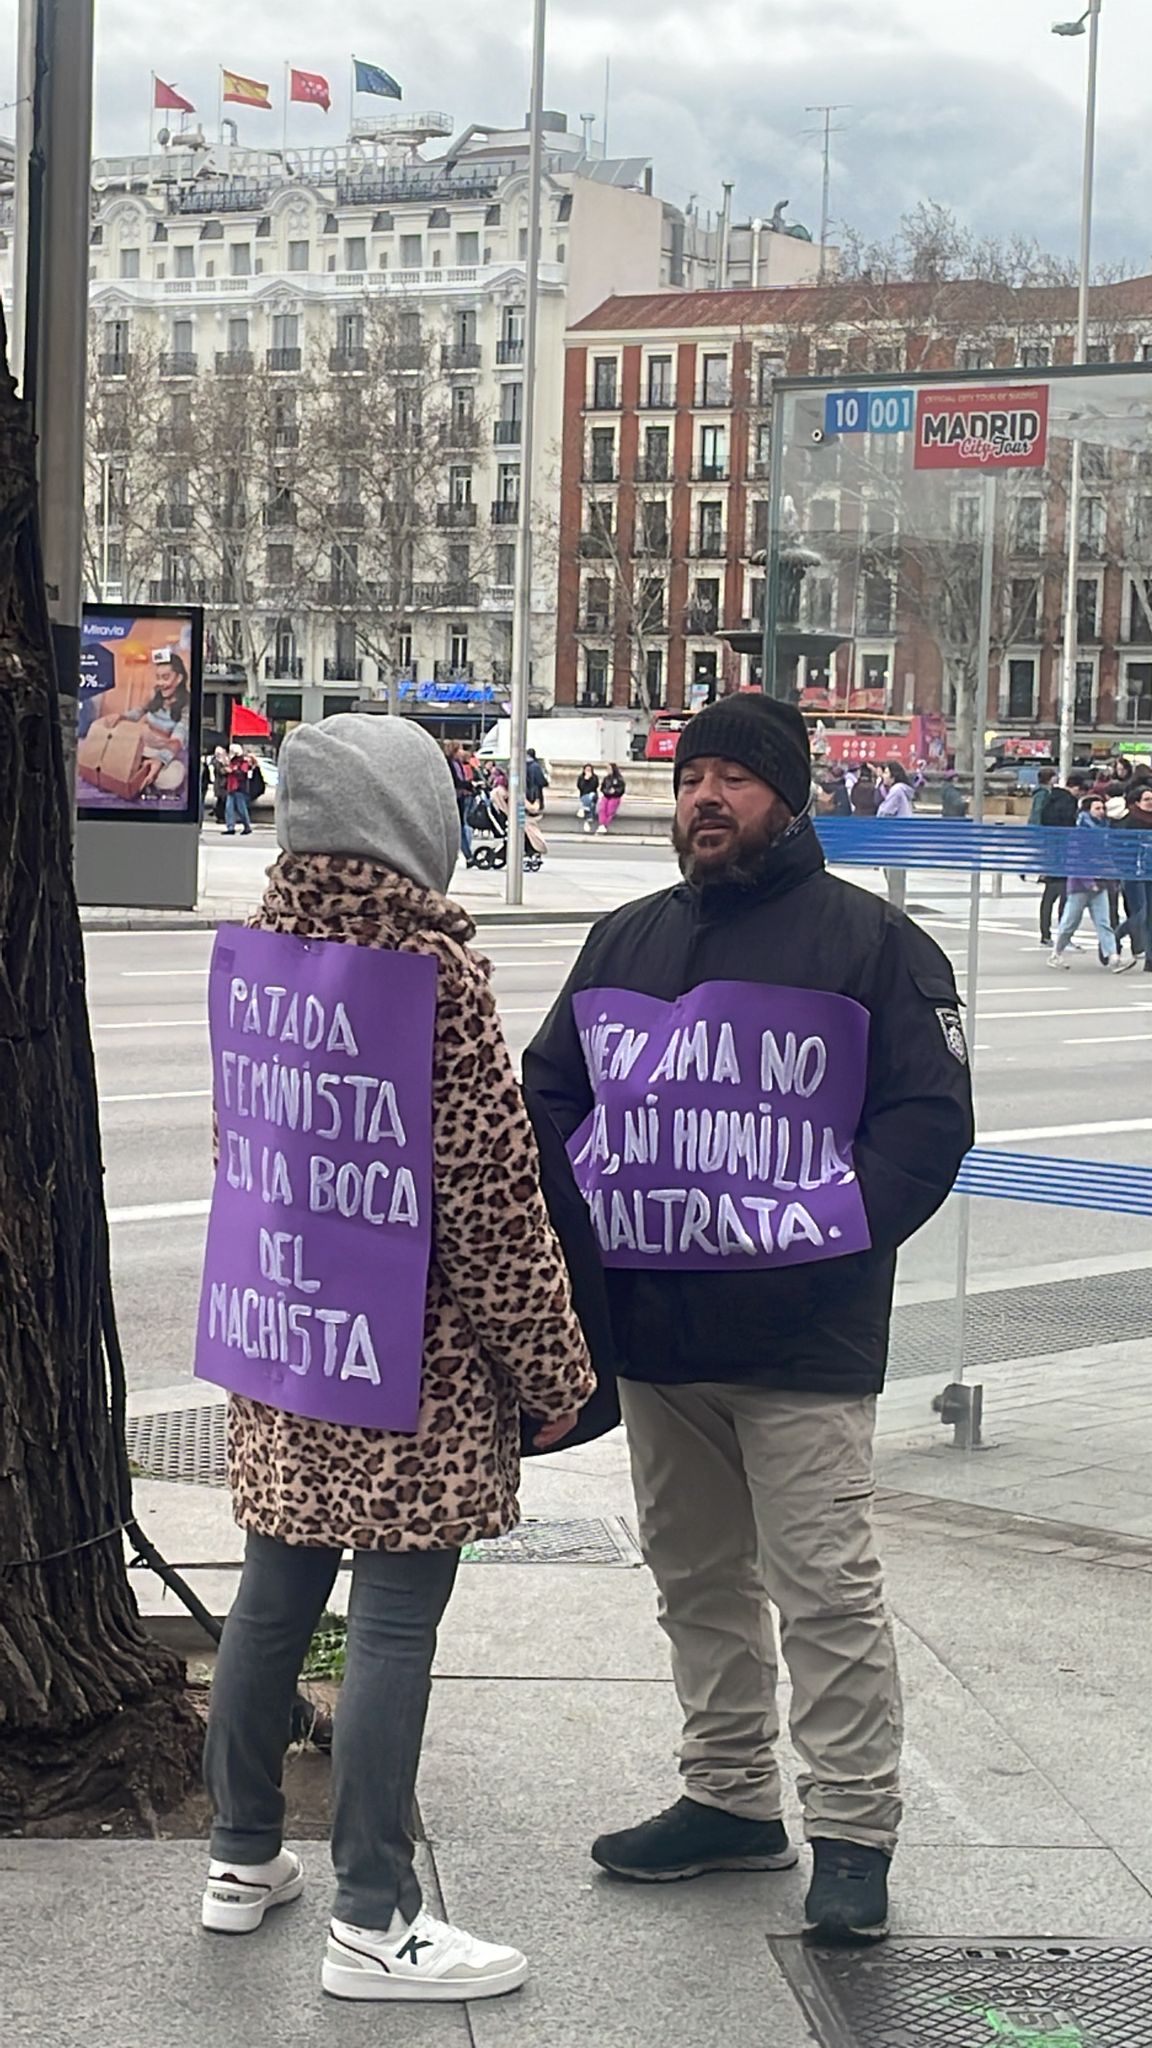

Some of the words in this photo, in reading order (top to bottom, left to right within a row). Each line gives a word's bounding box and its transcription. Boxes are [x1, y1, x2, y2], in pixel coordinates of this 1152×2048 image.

[836, 399, 859, 428] 10
[871, 397, 910, 429] 001
[922, 410, 1040, 448] MADRID
[959, 437, 995, 461] City
[993, 435, 1033, 457] Tour
[229, 977, 360, 1057] PATADA
[648, 1020, 741, 1085] AMA
[761, 1029, 827, 1098] NO
[226, 1129, 253, 1192] EN
[262, 1146, 293, 1207] LA
[309, 1155, 420, 1228] BOCA
[259, 1227, 321, 1295] DEL
[396, 1935, 434, 1965] K
